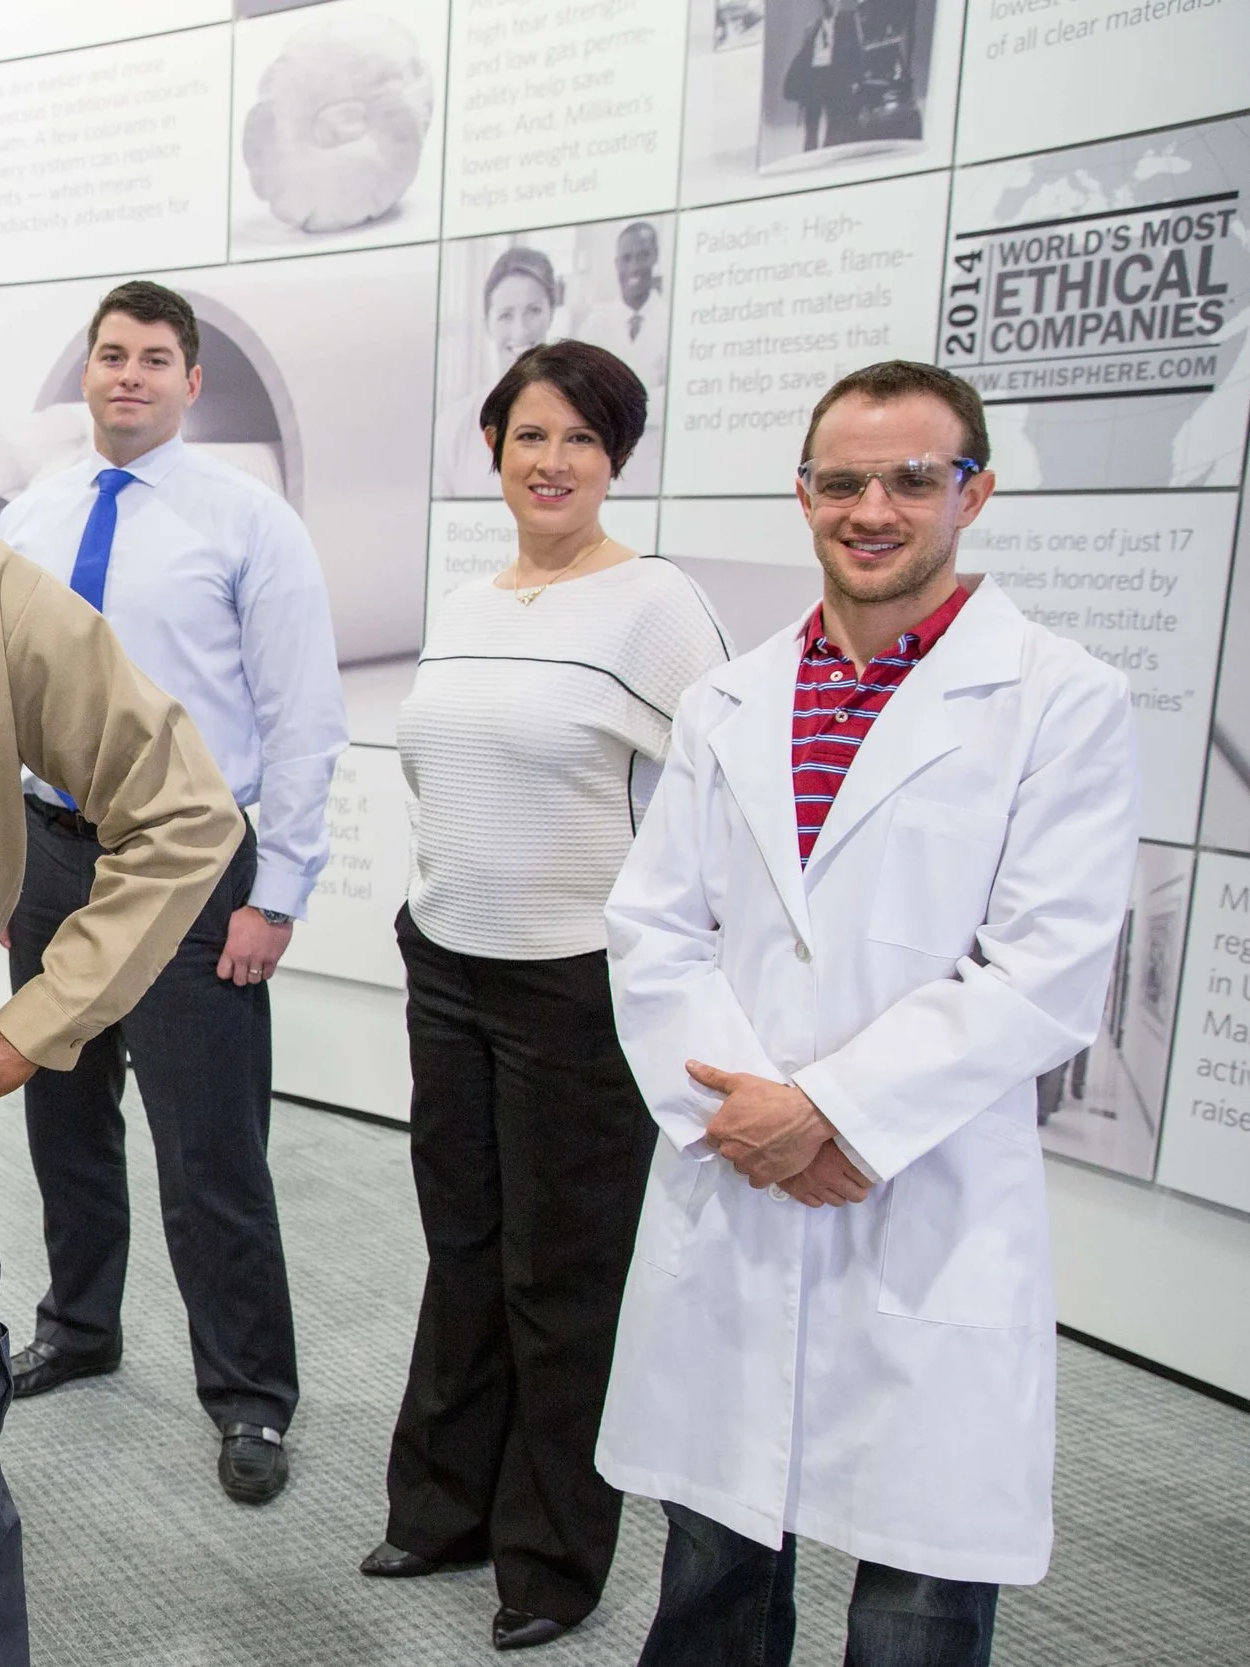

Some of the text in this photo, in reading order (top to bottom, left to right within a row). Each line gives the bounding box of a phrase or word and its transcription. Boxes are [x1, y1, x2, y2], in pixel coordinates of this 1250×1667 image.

[990, 0, 1060, 21] lowes
[986, 33, 1008, 59] of
[1014, 25, 1038, 54] all
[1044, 19, 1098, 46] clear
[466, 53, 500, 78] and
[506, 50, 538, 69] low
[544, 41, 577, 68] gas
[525, 75, 565, 98] help
[572, 69, 615, 92] save
[462, 130, 657, 175] lower weight coating
[461, 168, 597, 209] helps save fuel
[802, 211, 863, 242] High-
[999, 208, 1237, 267] WORLD'S MOST
[694, 247, 914, 294] performance, flame-
[993, 244, 1228, 318] ETHICAL
[691, 282, 892, 325] retardant materials
[945, 248, 983, 355] 2014
[690, 323, 890, 361] for mattresses that
[990, 300, 1224, 354] COMPANIES
[686, 378, 721, 396] can
[729, 369, 772, 394] help
[779, 370, 826, 391] save
[970, 355, 1217, 391] WW.ETHISPHERE.COM
[684, 408, 721, 431] and
[447, 521, 517, 542] BioSmar
[1027, 529, 1041, 551] is
[1049, 534, 1087, 551] one
[1093, 527, 1116, 551] of
[1117, 528, 1161, 557] just
[1169, 528, 1194, 553] 17
[445, 553, 511, 573] technol
[1053, 566, 1144, 591] honored
[1151, 569, 1178, 597] by
[1085, 606, 1178, 632] Institute
[1213, 933, 1250, 964] reg
[1208, 967, 1231, 996] in
[1202, 1009, 1250, 1043] Ma
